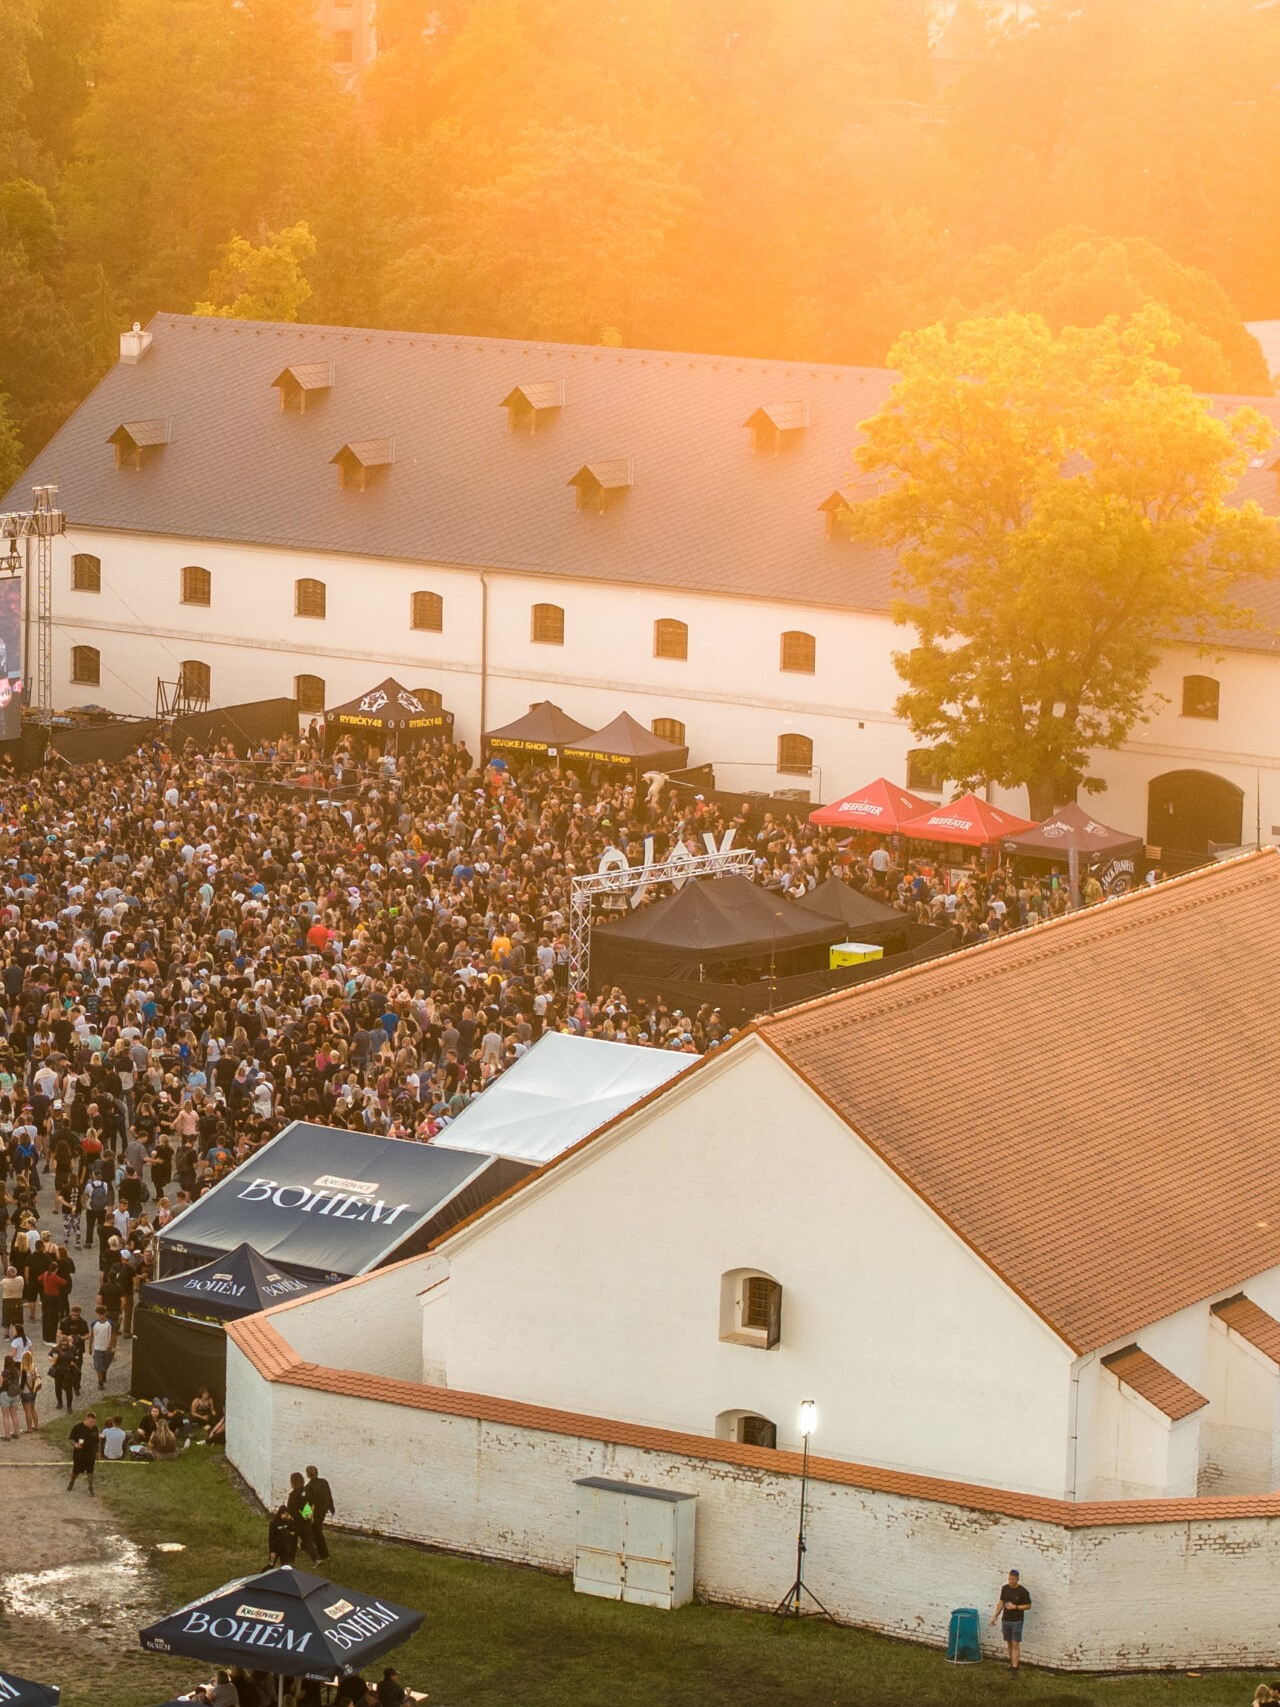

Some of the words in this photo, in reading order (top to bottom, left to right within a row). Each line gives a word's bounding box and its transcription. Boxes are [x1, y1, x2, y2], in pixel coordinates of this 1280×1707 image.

[525, 741, 547, 750] SHOP
[611, 756, 630, 764] SHOP
[838, 802, 883, 816] BEEFEATER
[927, 816, 972, 830] BEEFEATER
[237, 1178, 410, 1224] BOHÉM
[184, 1279, 246, 1297] BOHÉM
[182, 1611, 312, 1652] BOHÉM
[324, 1601, 400, 1650] BOHÉM
